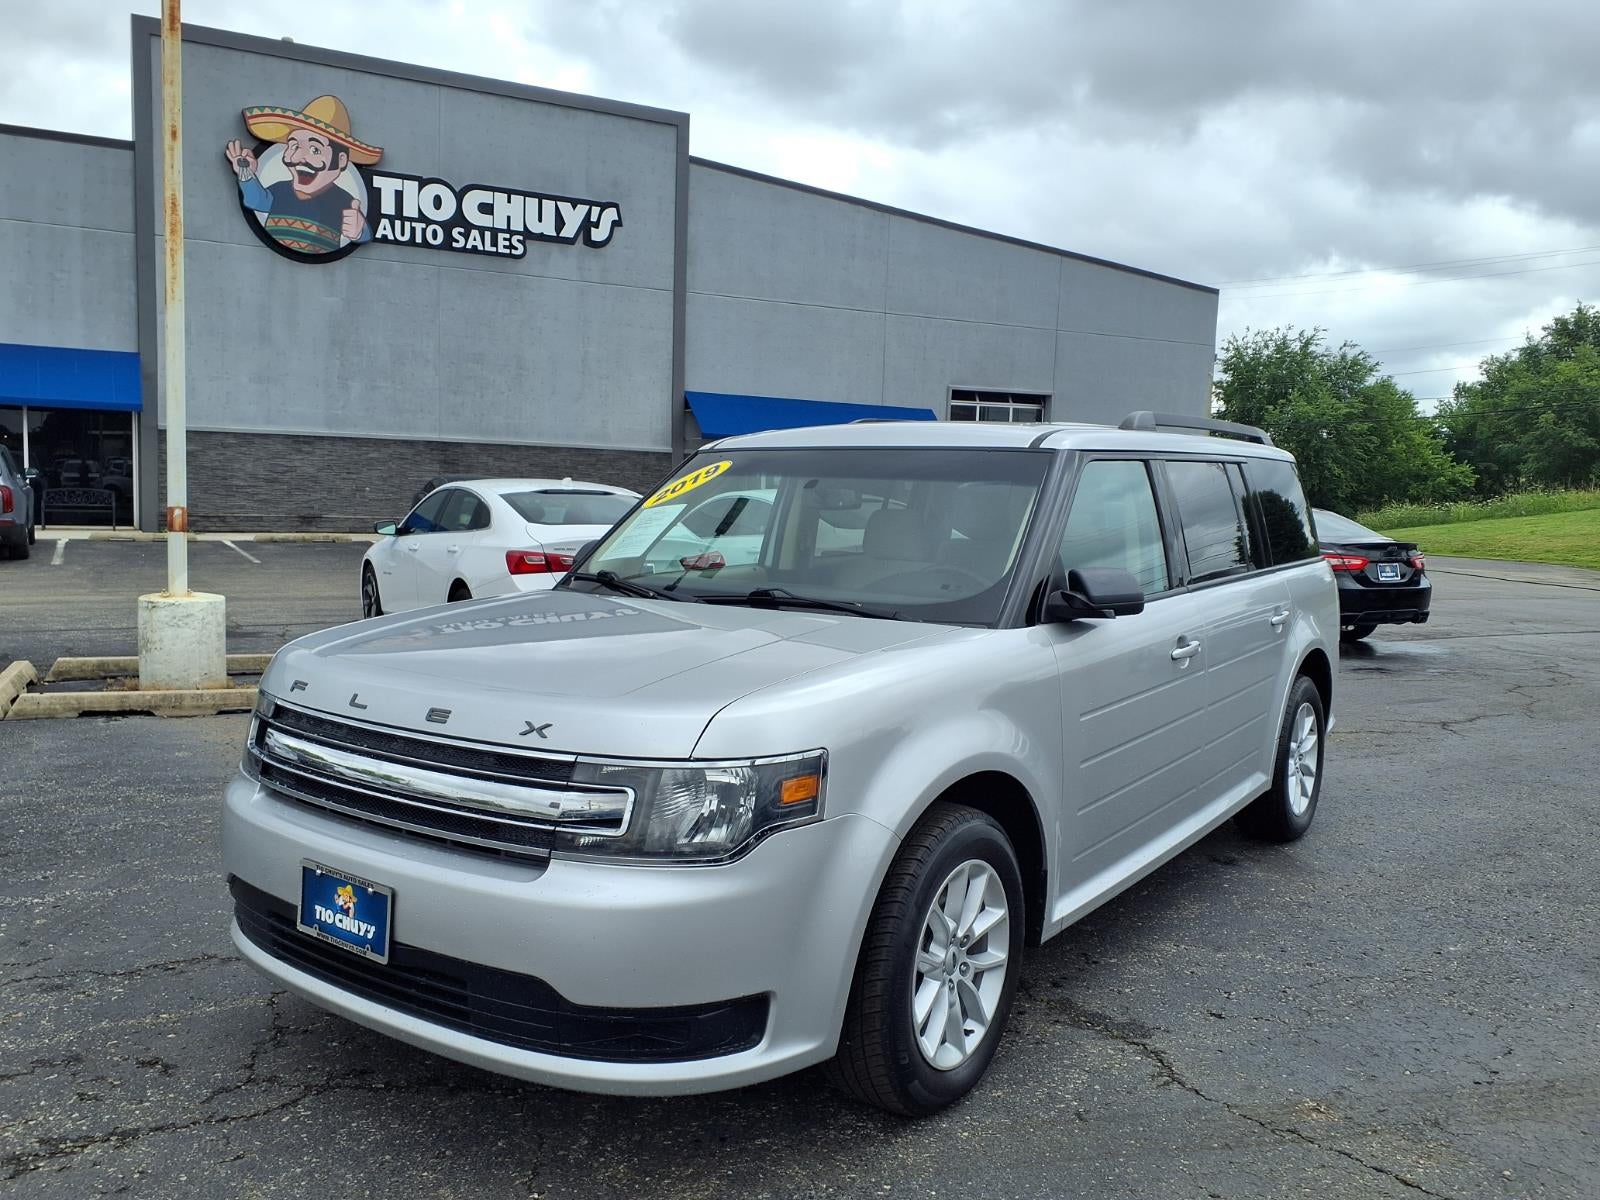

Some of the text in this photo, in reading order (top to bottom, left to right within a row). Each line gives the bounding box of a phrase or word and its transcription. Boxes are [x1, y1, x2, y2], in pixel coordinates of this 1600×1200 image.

[372, 175, 619, 242] TIO CHUY'S
[375, 218, 525, 256] AUTO SALES
[651, 464, 721, 505] 2019
[289, 679, 553, 739] FLEX
[314, 904, 376, 939] TIO CHUY'S
